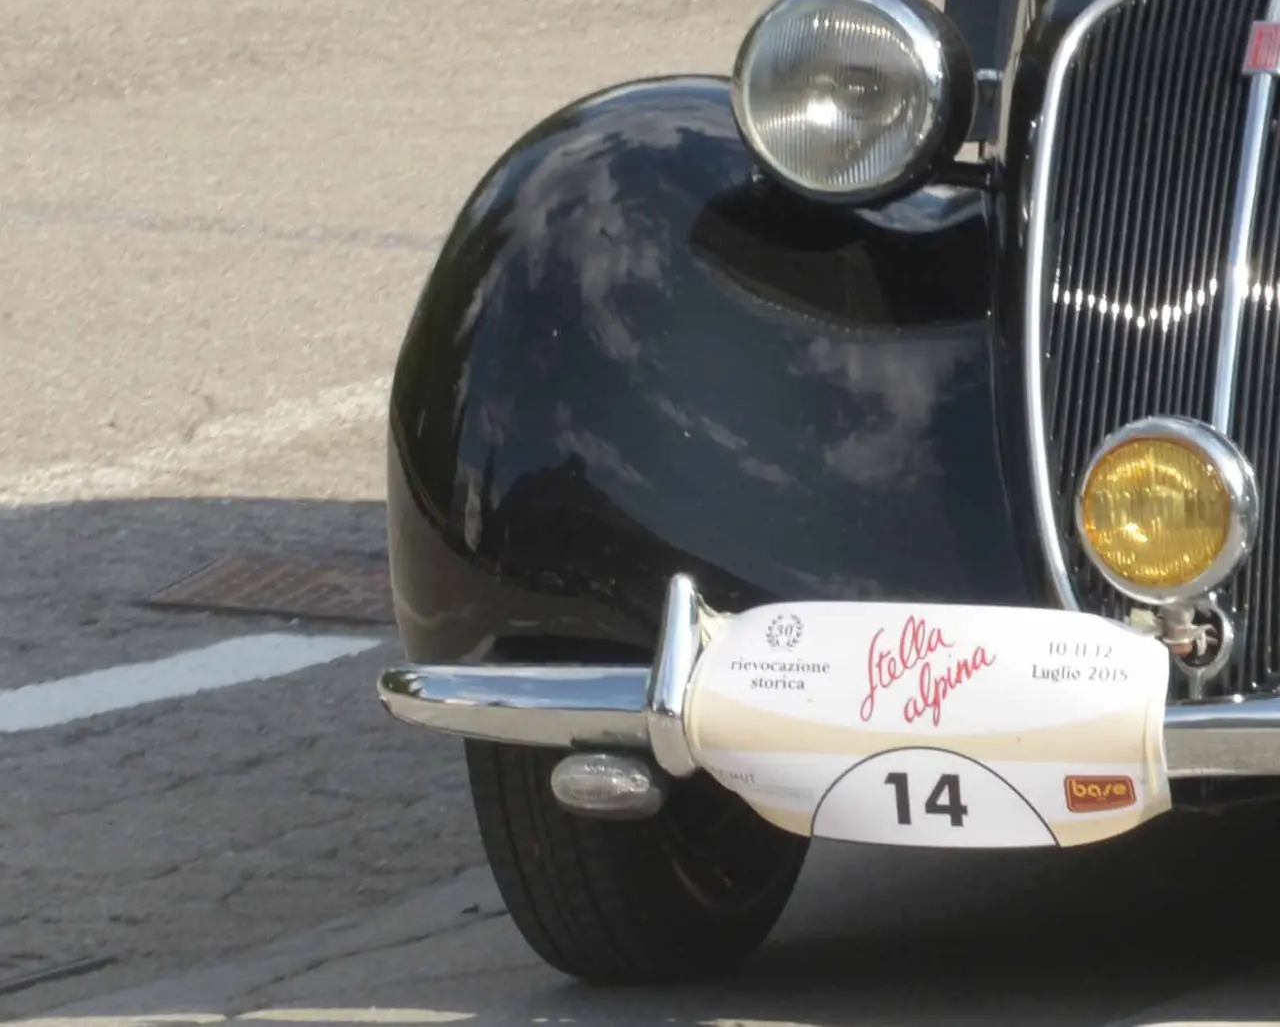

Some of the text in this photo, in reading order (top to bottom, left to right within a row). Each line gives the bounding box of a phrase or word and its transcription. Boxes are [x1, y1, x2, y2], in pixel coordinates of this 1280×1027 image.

[1048, 641, 1068, 657] 10
[728, 656, 832, 674] rievocazione
[859, 614, 956, 723] Stella
[1031, 663, 1129, 683] Luglio 2015
[750, 674, 805, 691] storica
[903, 645, 997, 728] alpina
[883, 771, 969, 828] 14
